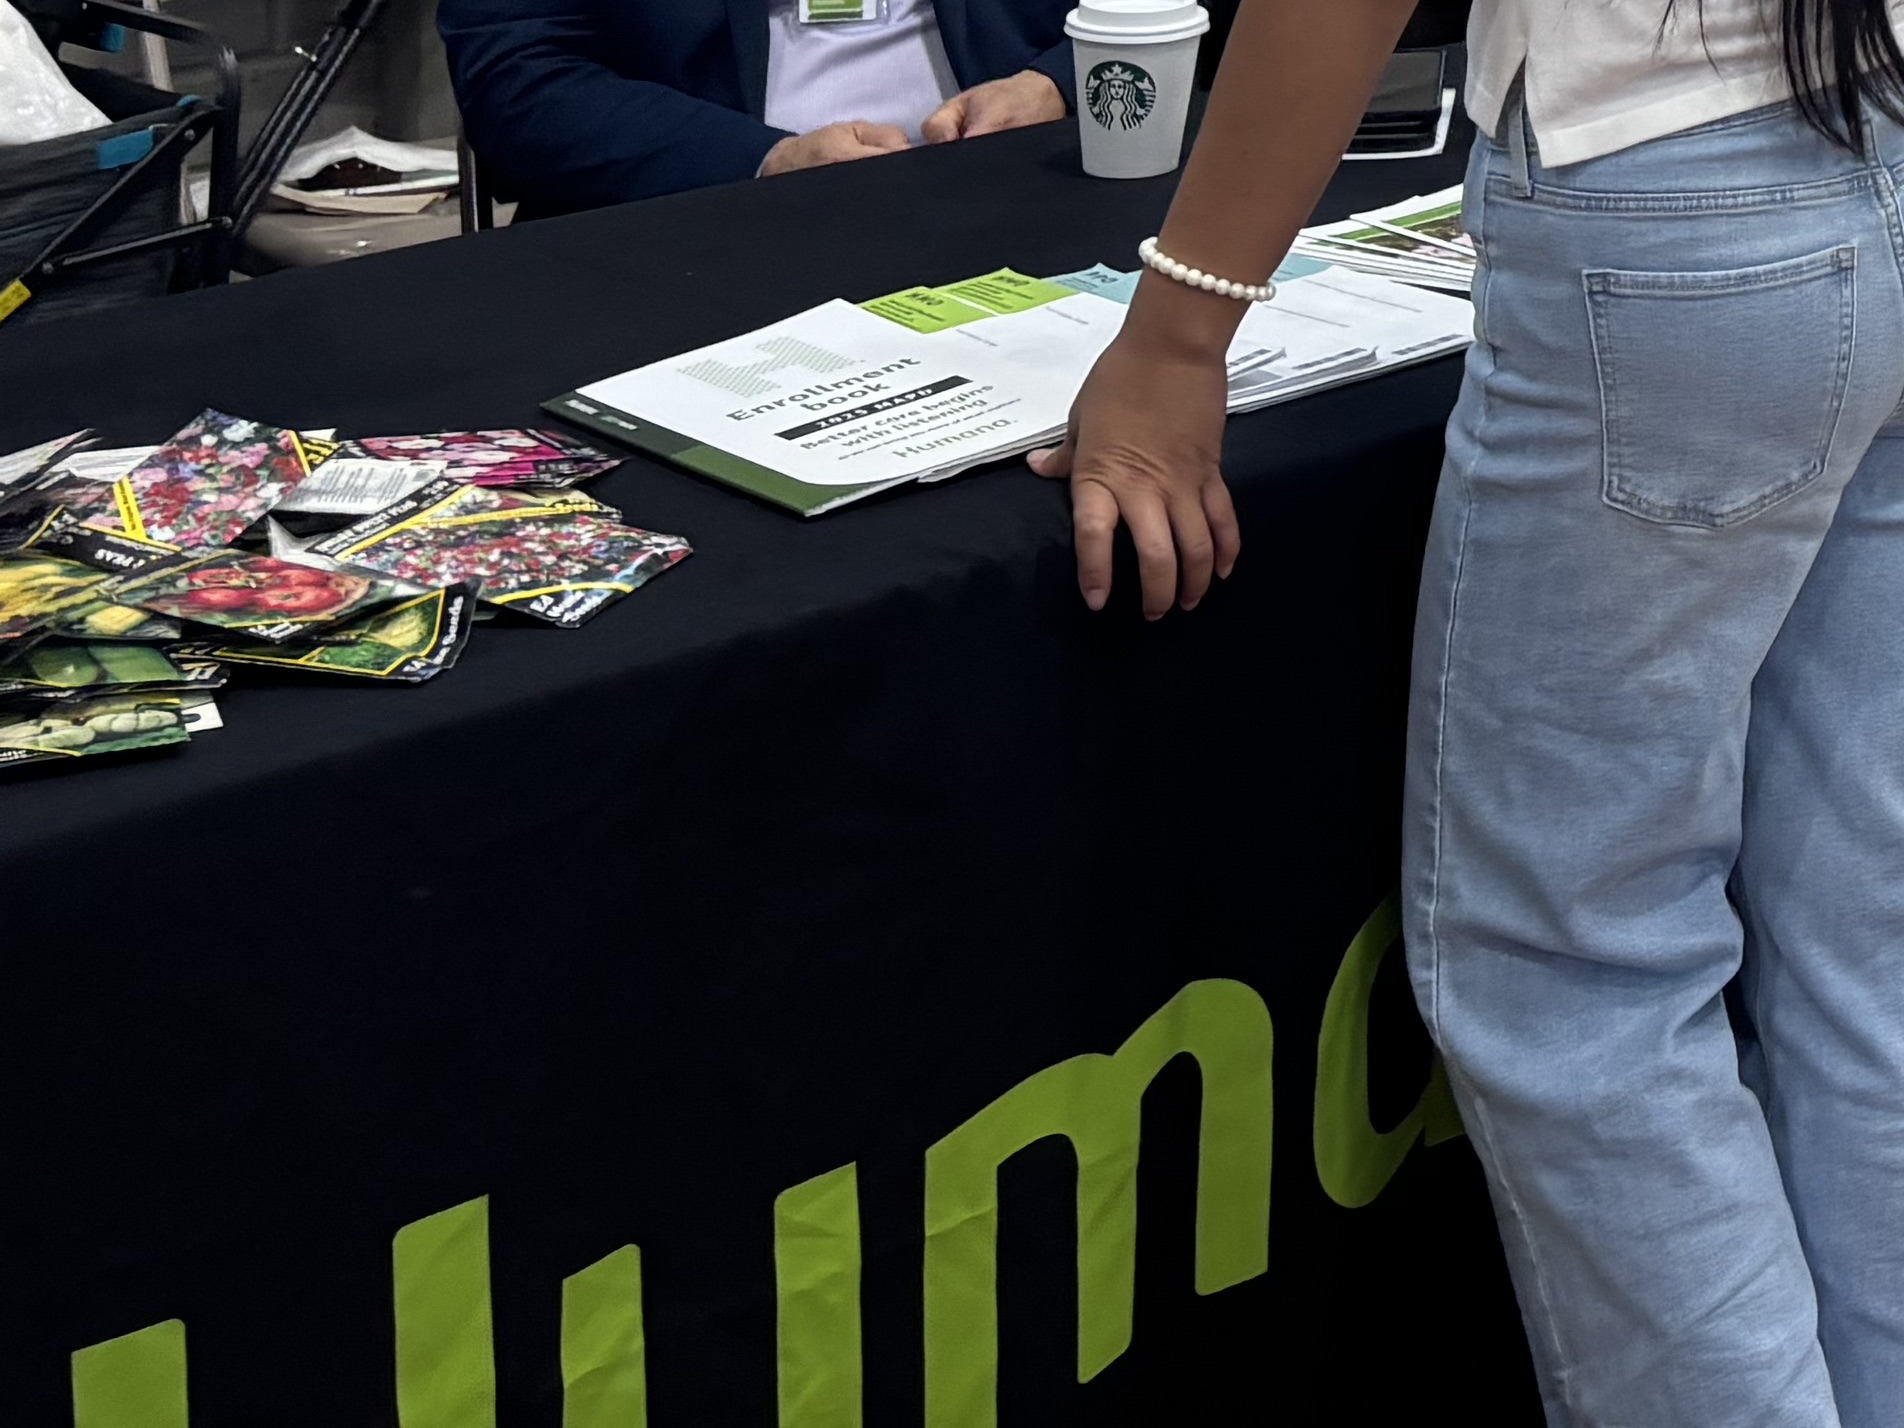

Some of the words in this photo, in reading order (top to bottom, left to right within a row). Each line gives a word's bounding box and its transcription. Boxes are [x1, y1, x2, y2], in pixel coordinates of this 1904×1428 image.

[726, 357, 921, 422] Enrollment
[800, 382, 891, 412] book
[800, 425, 868, 450] Better
[875, 409, 921, 426] care
[922, 384, 994, 410] begins
[816, 408, 869, 430] 2025
[842, 429, 891, 448] with
[893, 398, 988, 432] listening
